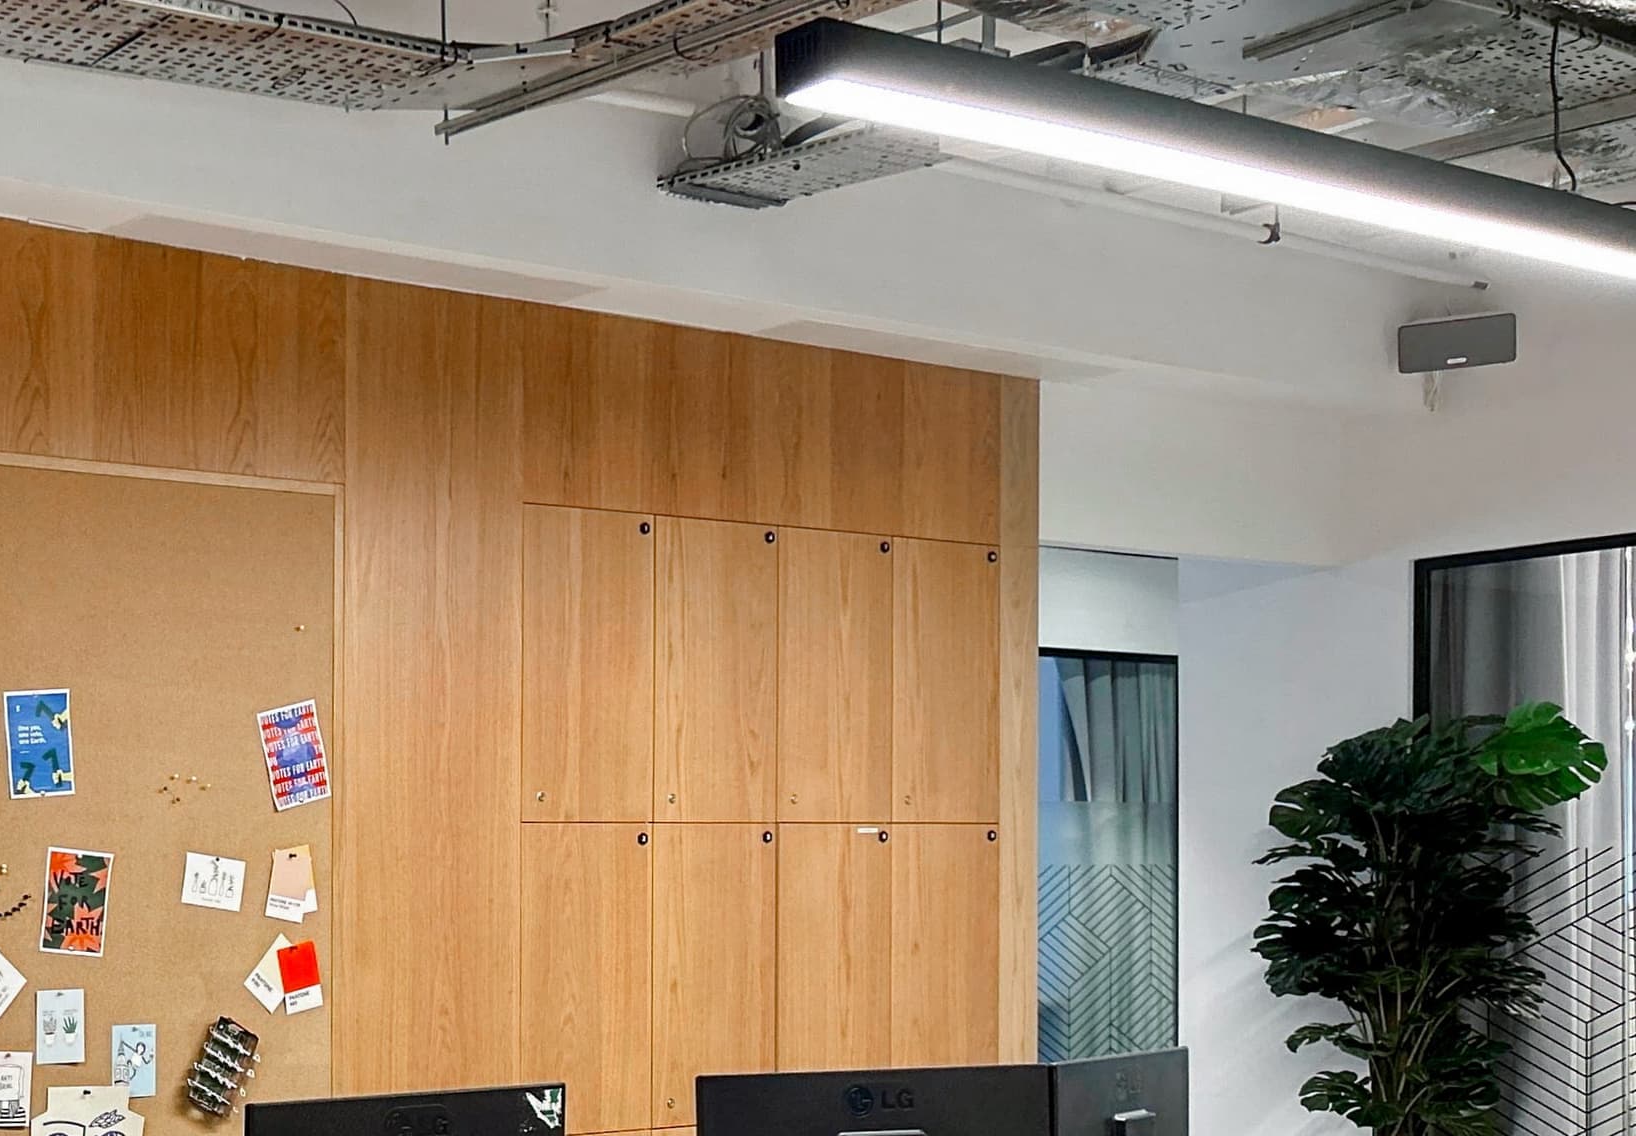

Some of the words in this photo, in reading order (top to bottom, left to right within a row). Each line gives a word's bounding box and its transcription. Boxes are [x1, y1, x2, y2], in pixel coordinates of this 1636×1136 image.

[53, 869, 88, 889] VOTE
[58, 894, 91, 911] FOR
[880, 1089, 915, 1111] LG
